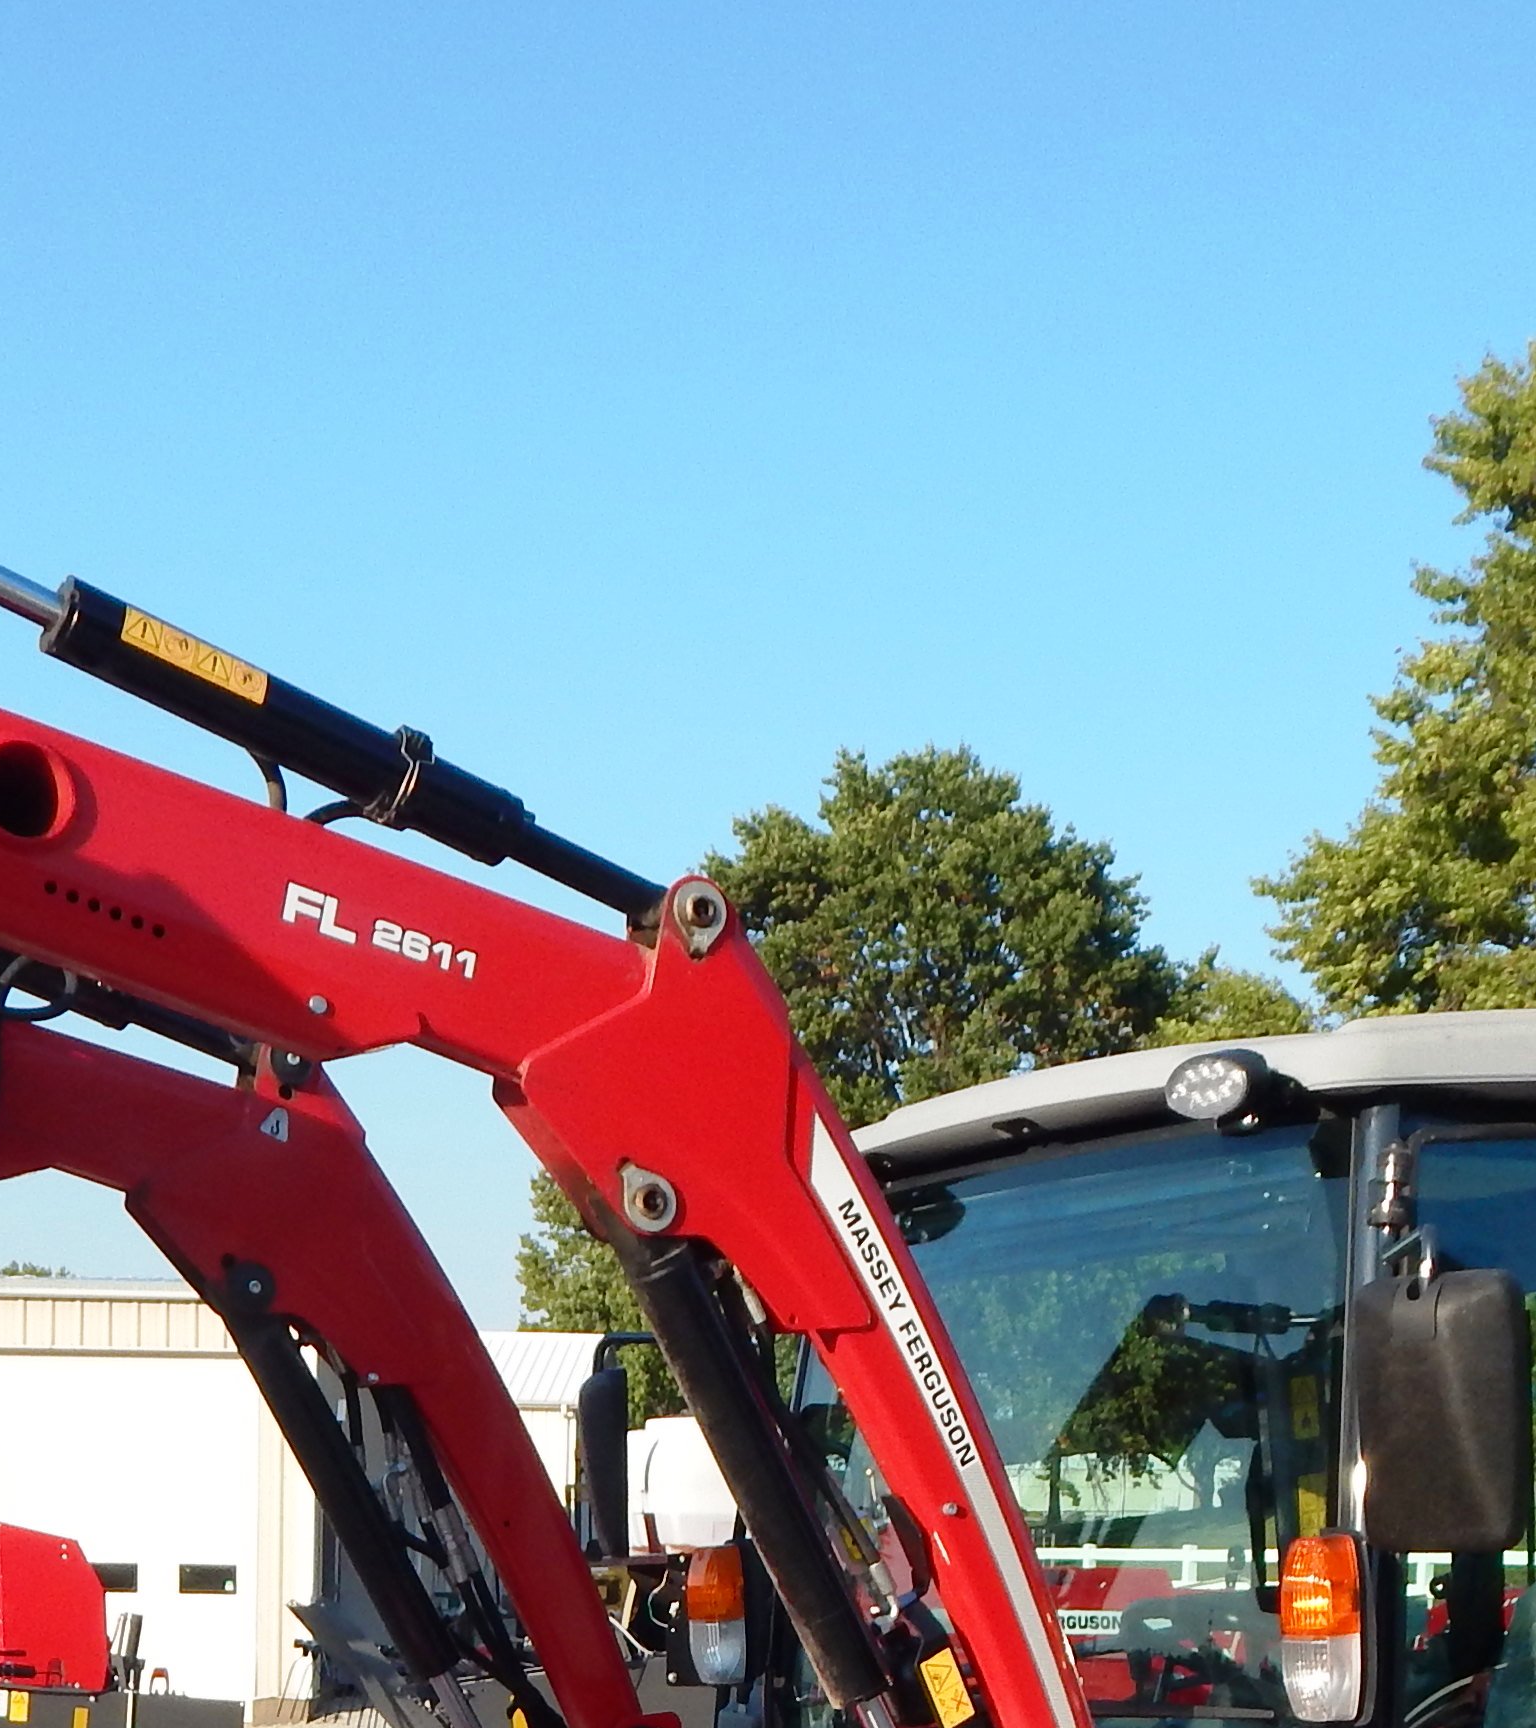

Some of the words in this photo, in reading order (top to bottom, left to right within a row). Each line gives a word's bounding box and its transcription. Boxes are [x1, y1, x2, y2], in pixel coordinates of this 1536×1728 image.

[282, 881, 357, 945] FL
[372, 919, 478, 979] 2611
[838, 1198, 907, 1311] MASSEY
[899, 1319, 977, 1468] FERGUSON
[1059, 1615, 1123, 1630] GUSON
